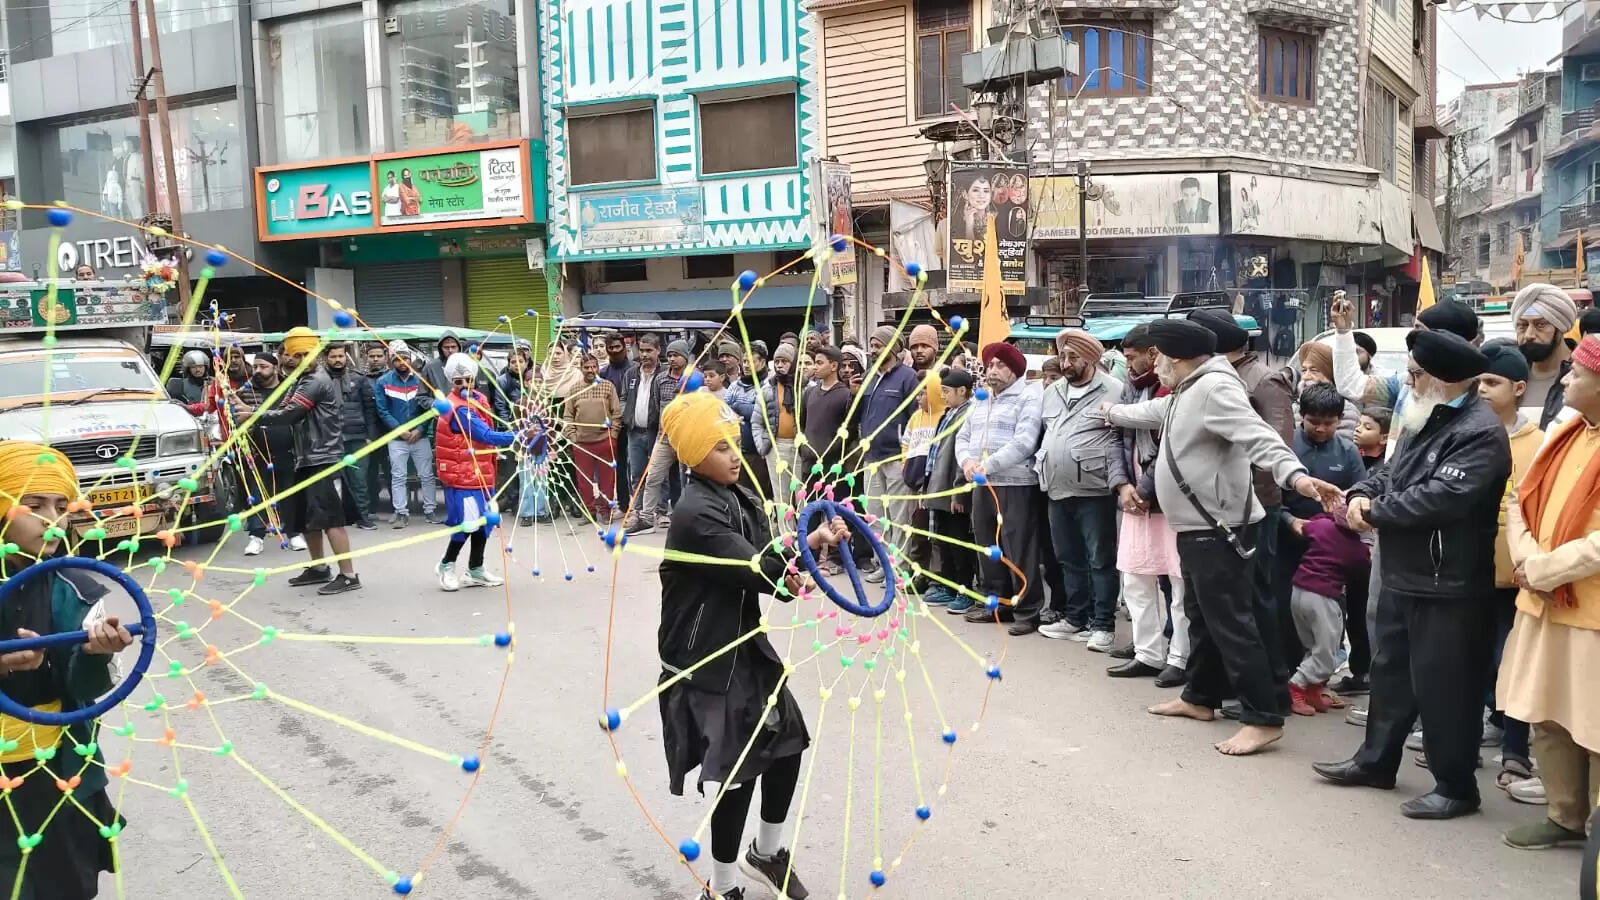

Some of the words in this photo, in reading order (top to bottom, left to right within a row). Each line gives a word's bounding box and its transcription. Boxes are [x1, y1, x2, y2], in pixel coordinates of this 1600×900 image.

[488, 158, 515, 175] दिव्य
[428, 196, 444, 208] मेगा
[447, 194, 465, 207] स्टोर
[600, 199, 640, 219] राजीव
[644, 196, 677, 219] ट्रेडर्स
[1037, 228, 1077, 237] SAMEER
[1136, 225, 1191, 235] NAUTANWA
[99, 492, 112, 503] 56
[114, 491, 120, 501] T
[122, 488, 148, 500] 214
